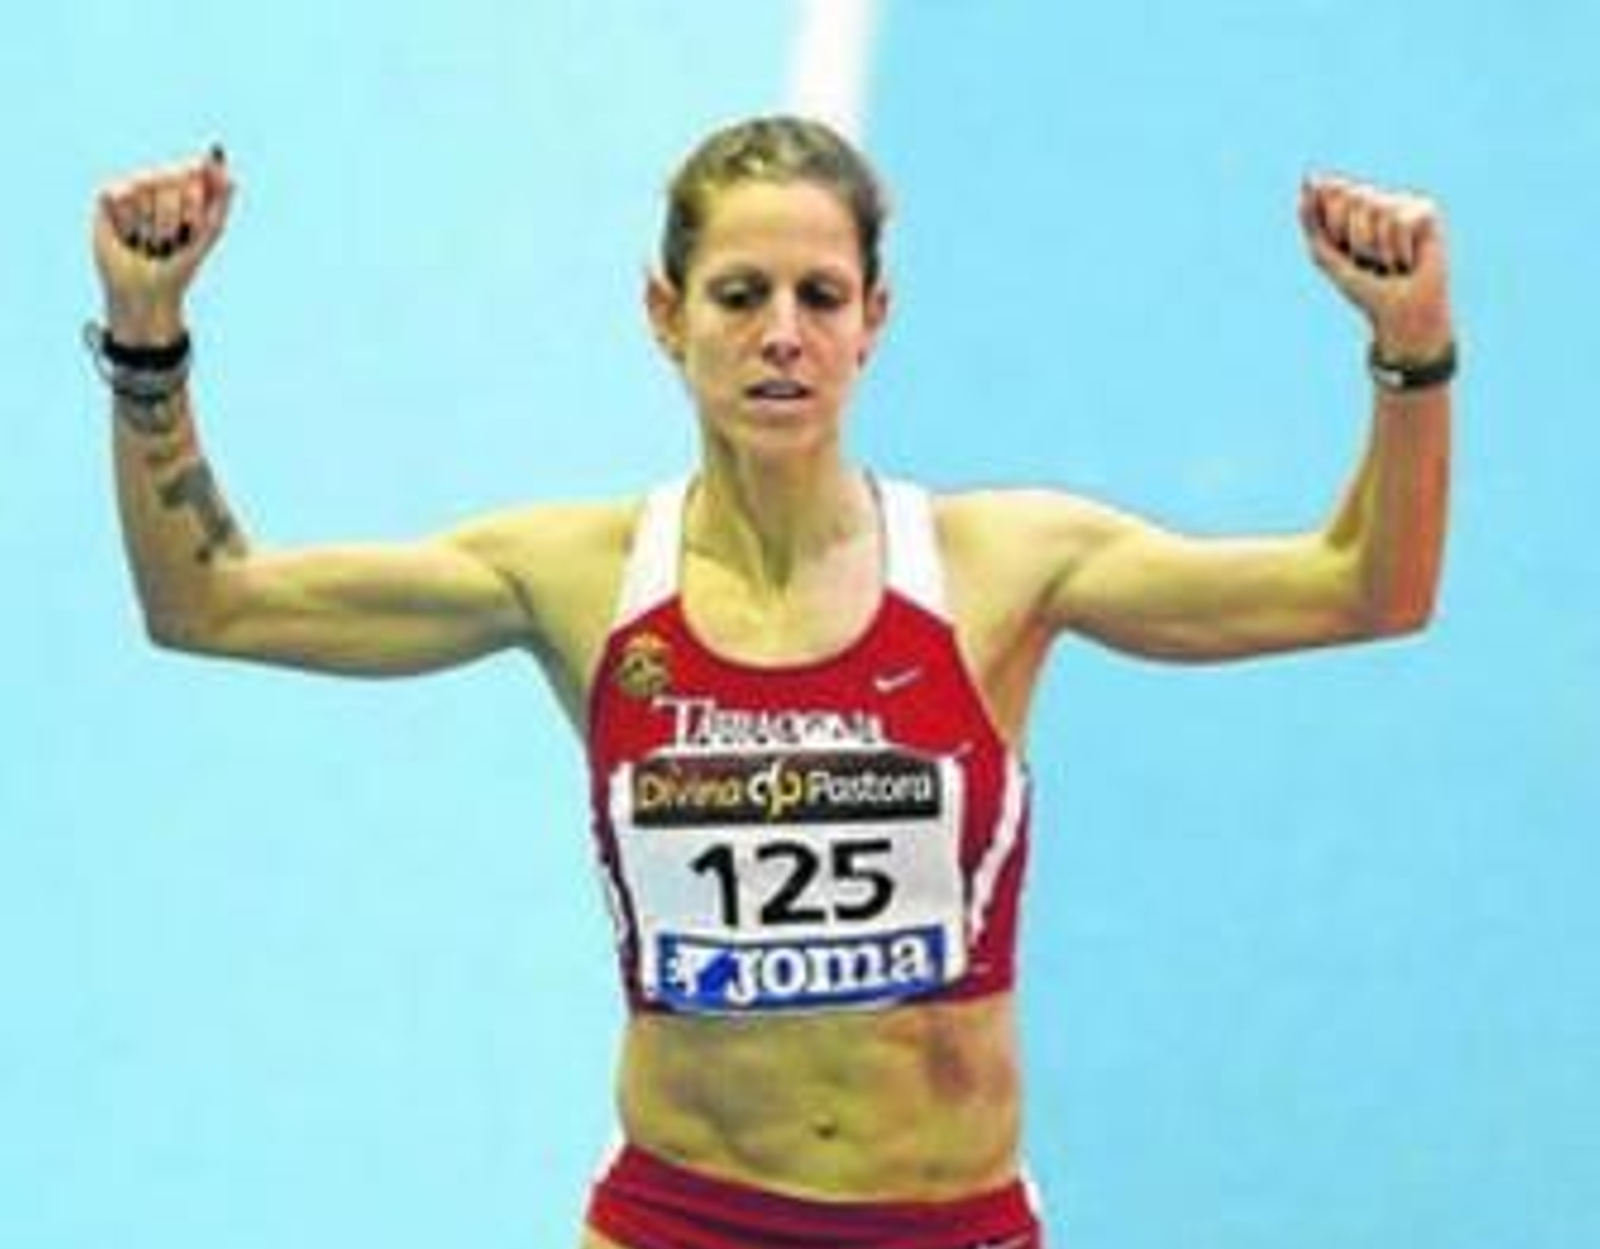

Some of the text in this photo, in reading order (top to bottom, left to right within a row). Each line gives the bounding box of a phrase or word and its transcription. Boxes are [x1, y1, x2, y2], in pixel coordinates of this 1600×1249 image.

[638, 763, 740, 808] Divina
[807, 769, 931, 803] Pastora
[689, 838, 896, 928] 125
